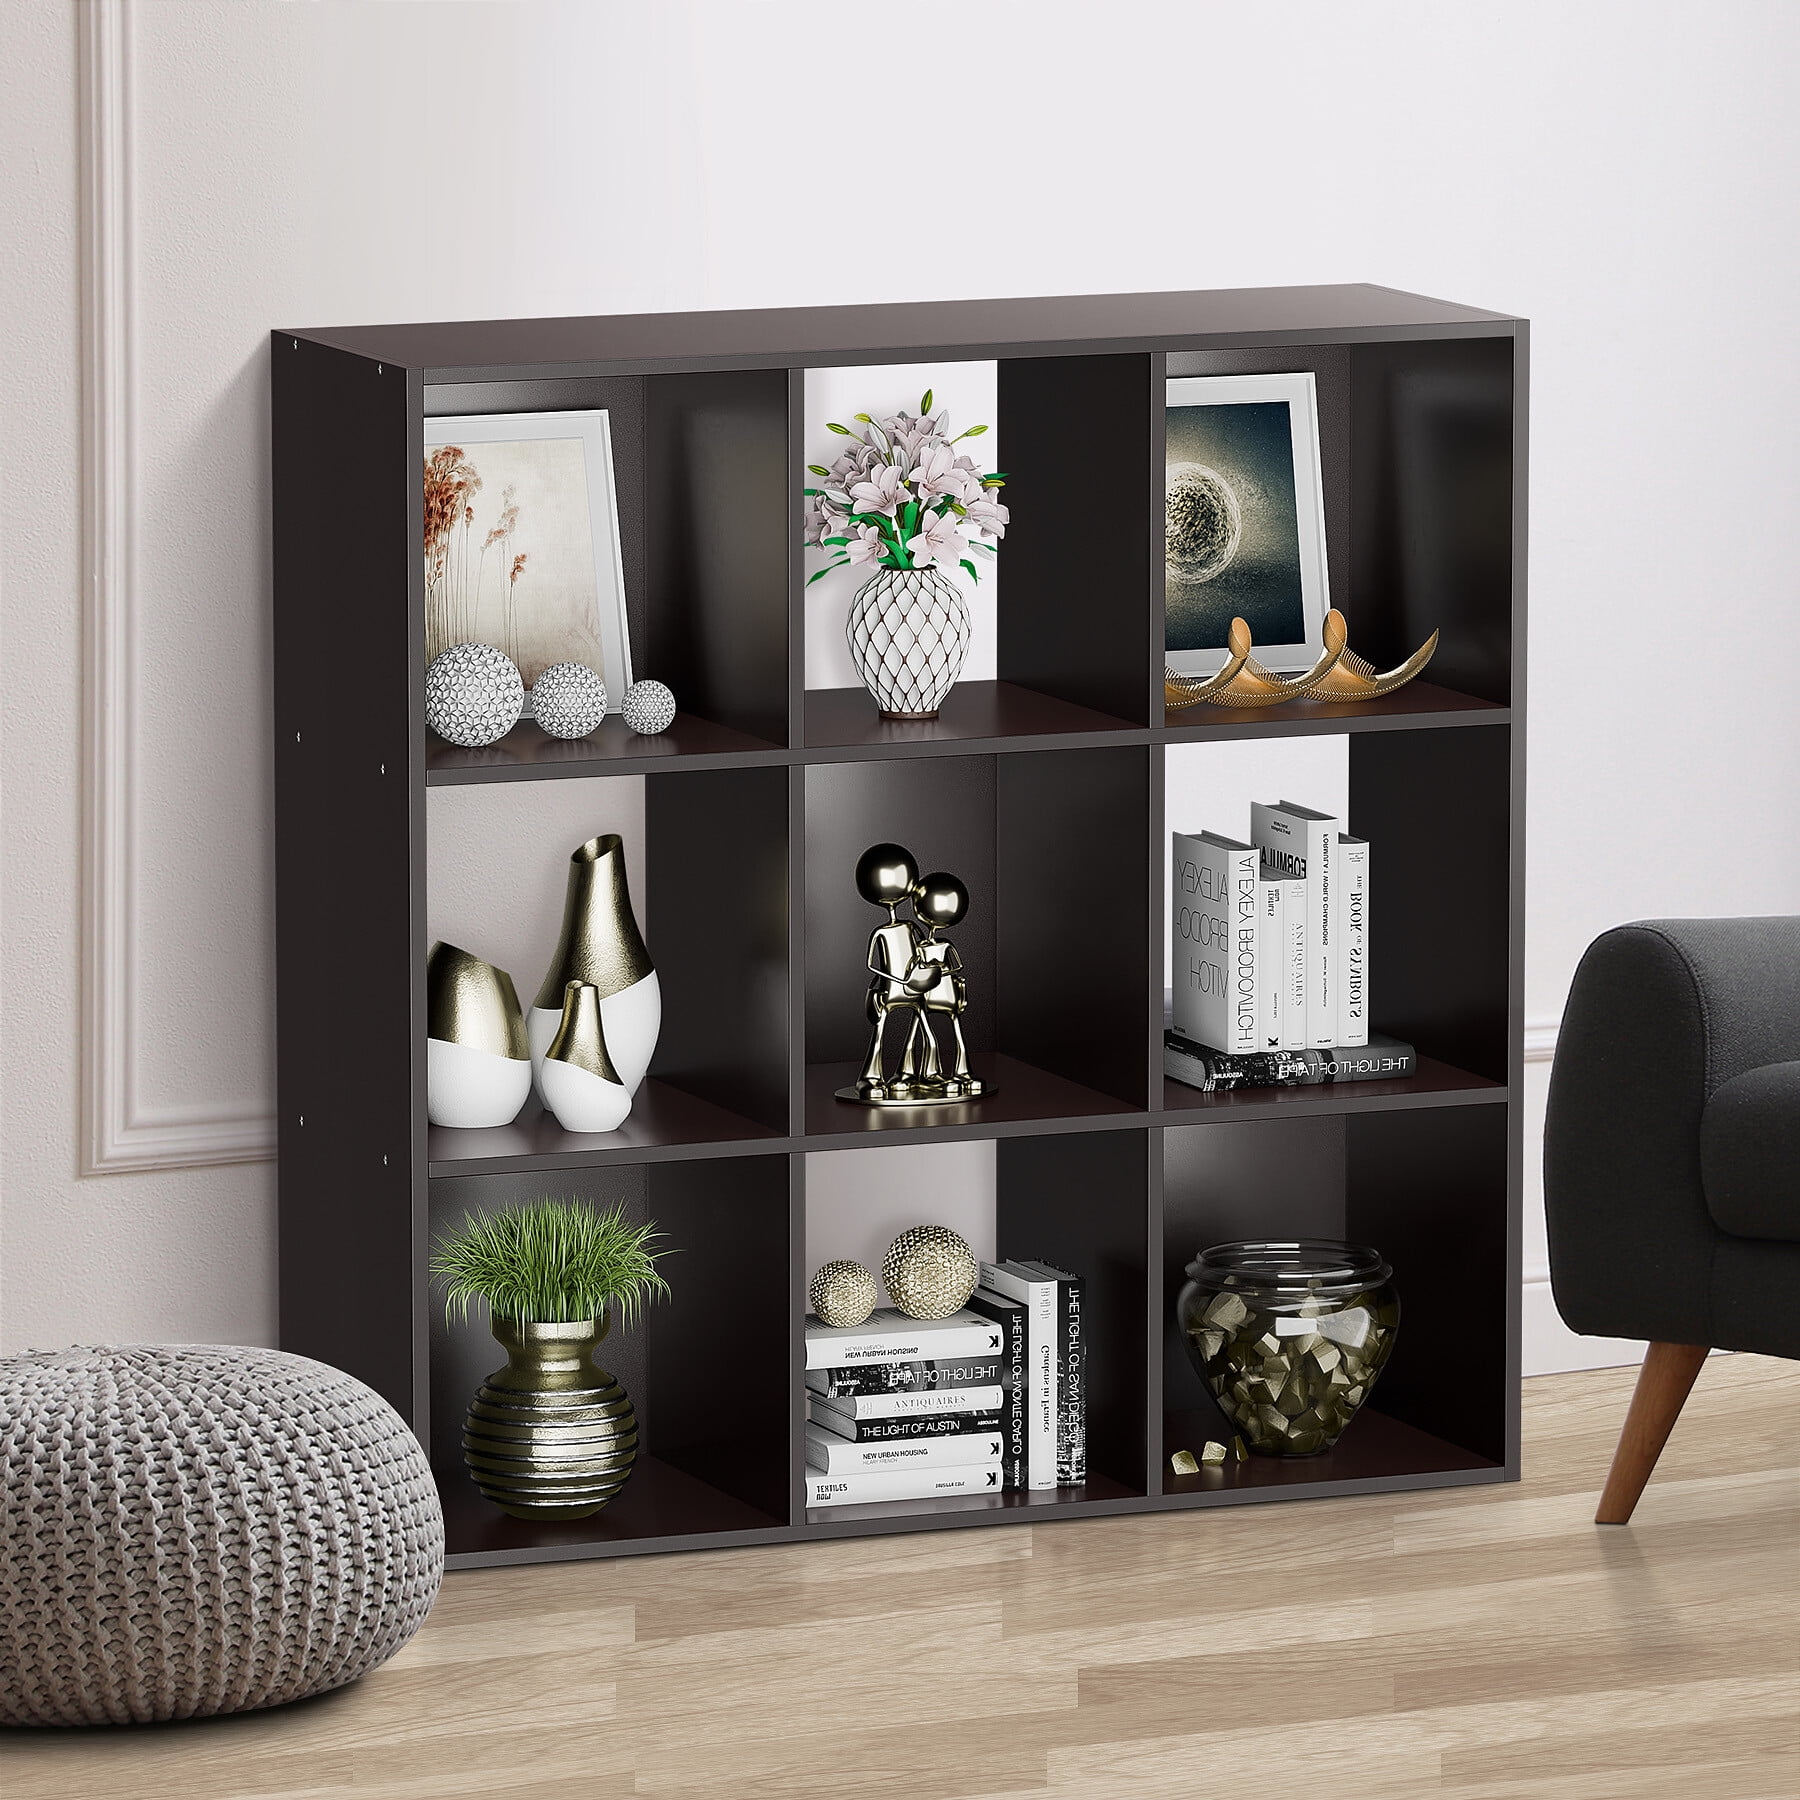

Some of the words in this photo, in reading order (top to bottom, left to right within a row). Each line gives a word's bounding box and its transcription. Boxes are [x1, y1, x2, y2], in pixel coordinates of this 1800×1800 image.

[1294, 922, 1304, 1007] ANTIQUAIRES
[894, 1395, 966, 1409] ANTIQUAIRES
[862, 1426, 881, 1437] THE
[882, 1423, 910, 1436] LIGHT
[911, 1422, 926, 1433] OF
[926, 1420, 960, 1432] AUSTIN
[878, 1451, 900, 1459] URBAN
[900, 1448, 928, 1457] HOUSING
[816, 1483, 848, 1493] TEXTILES
